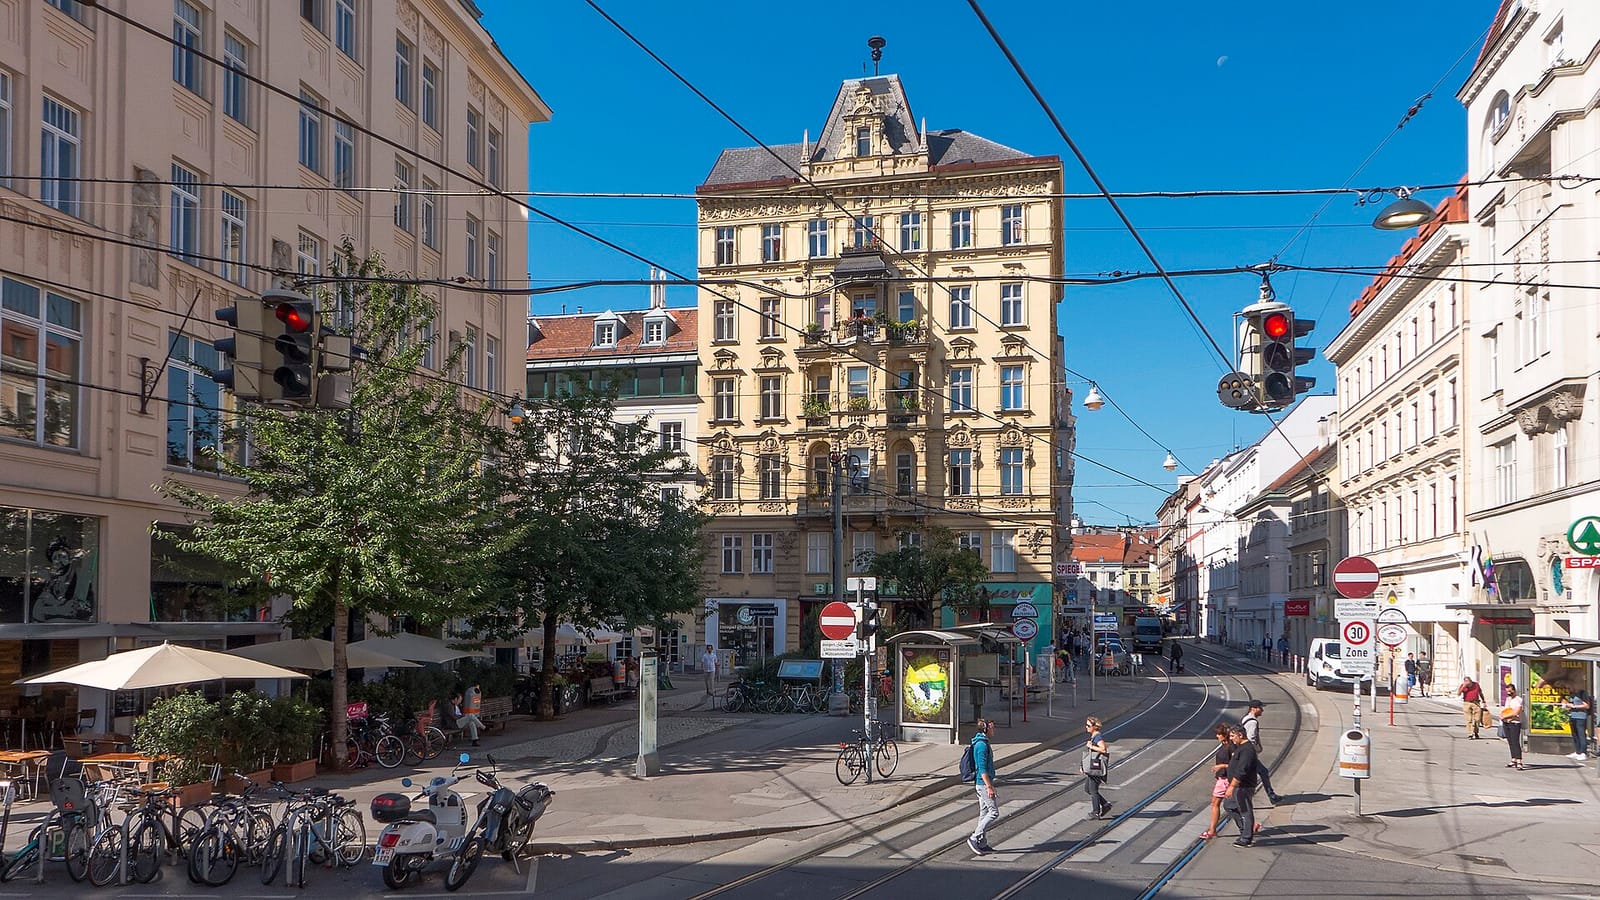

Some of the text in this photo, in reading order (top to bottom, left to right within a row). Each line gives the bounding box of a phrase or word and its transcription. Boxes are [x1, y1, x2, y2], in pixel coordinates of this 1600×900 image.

[1057, 564, 1084, 574] SPIEGEL
[1350, 627, 1364, 640] 30
[1345, 647, 1369, 658] Zone
